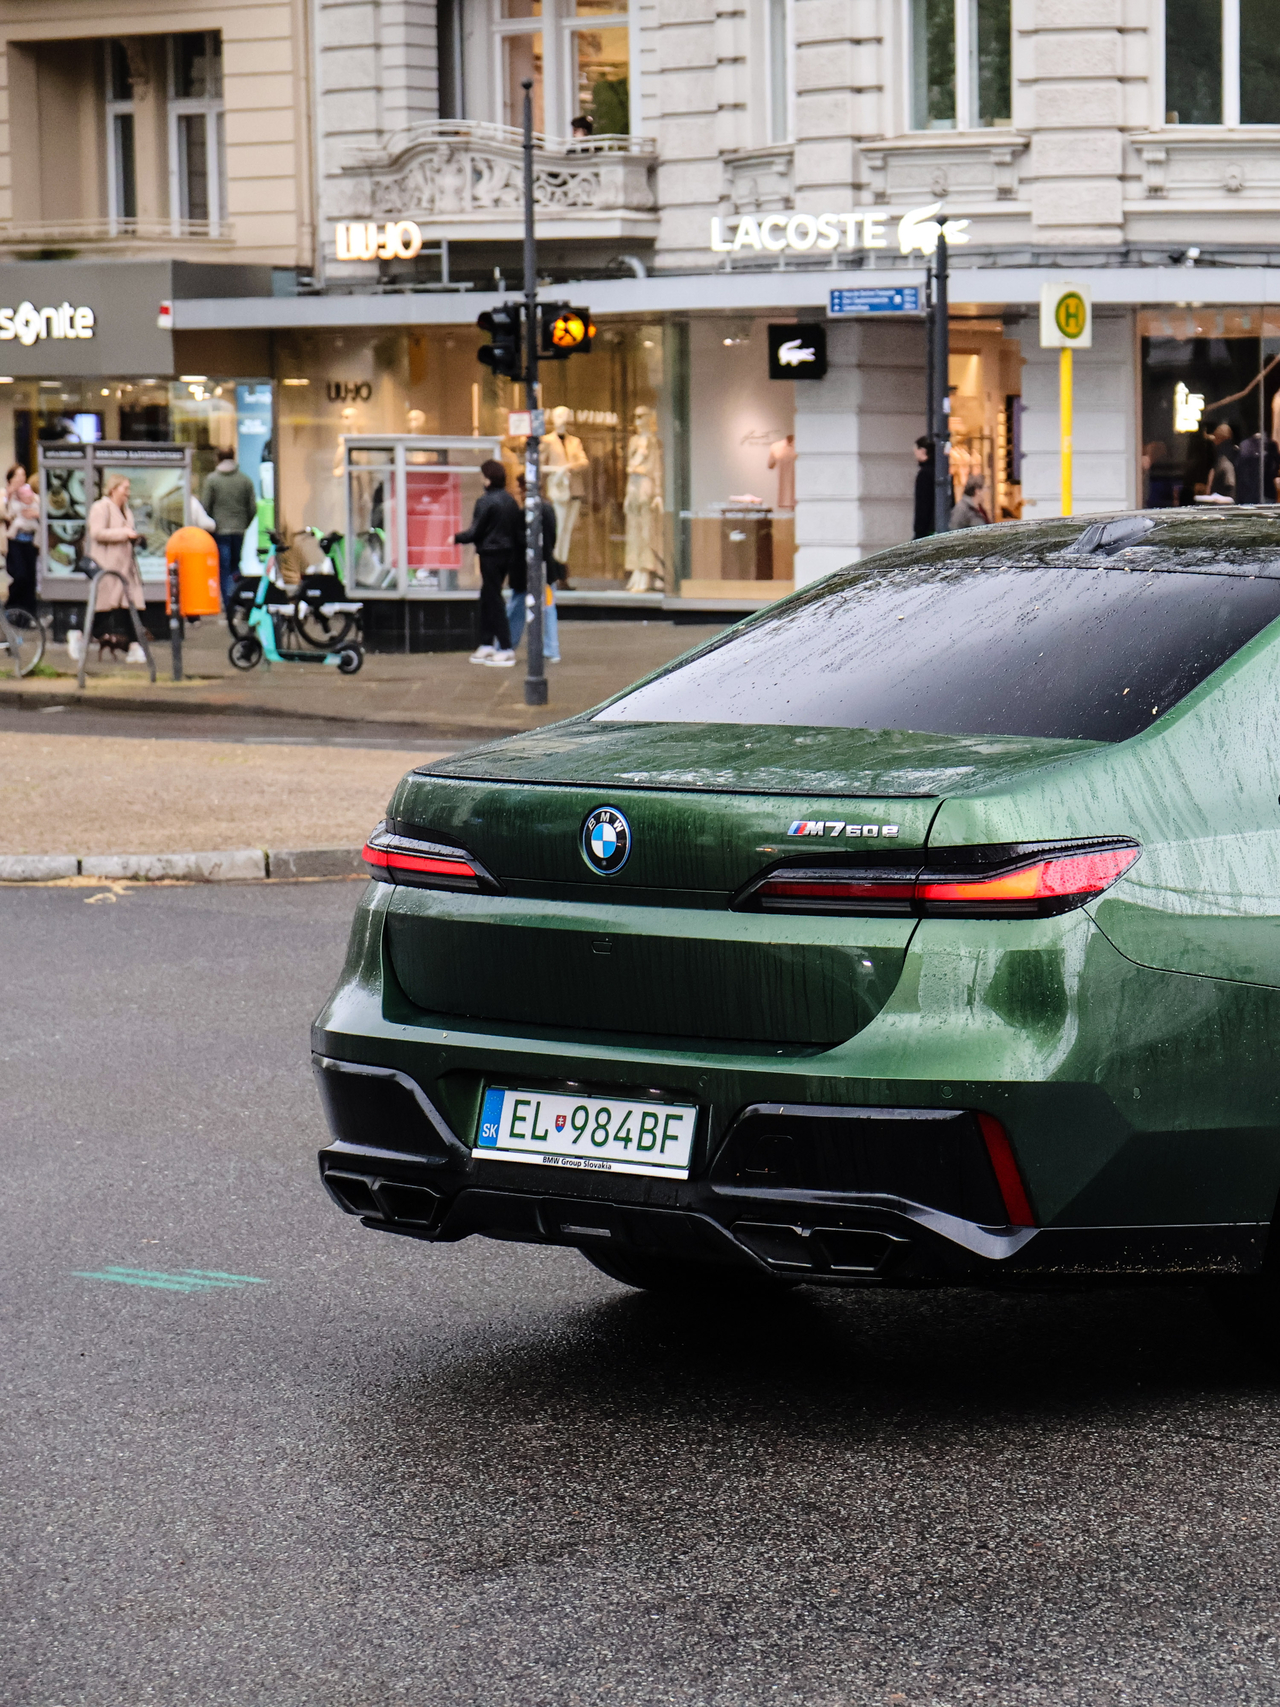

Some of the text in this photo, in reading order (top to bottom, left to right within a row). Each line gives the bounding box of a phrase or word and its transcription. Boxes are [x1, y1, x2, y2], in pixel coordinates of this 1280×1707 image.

[710, 212, 888, 251] LACOSTE
[587, 811, 625, 833] BMW
[481, 1122, 499, 1139] SK
[508, 1098, 684, 1154] EL 984BF
[542, 1155, 612, 1170] BMW Group Slovakia
